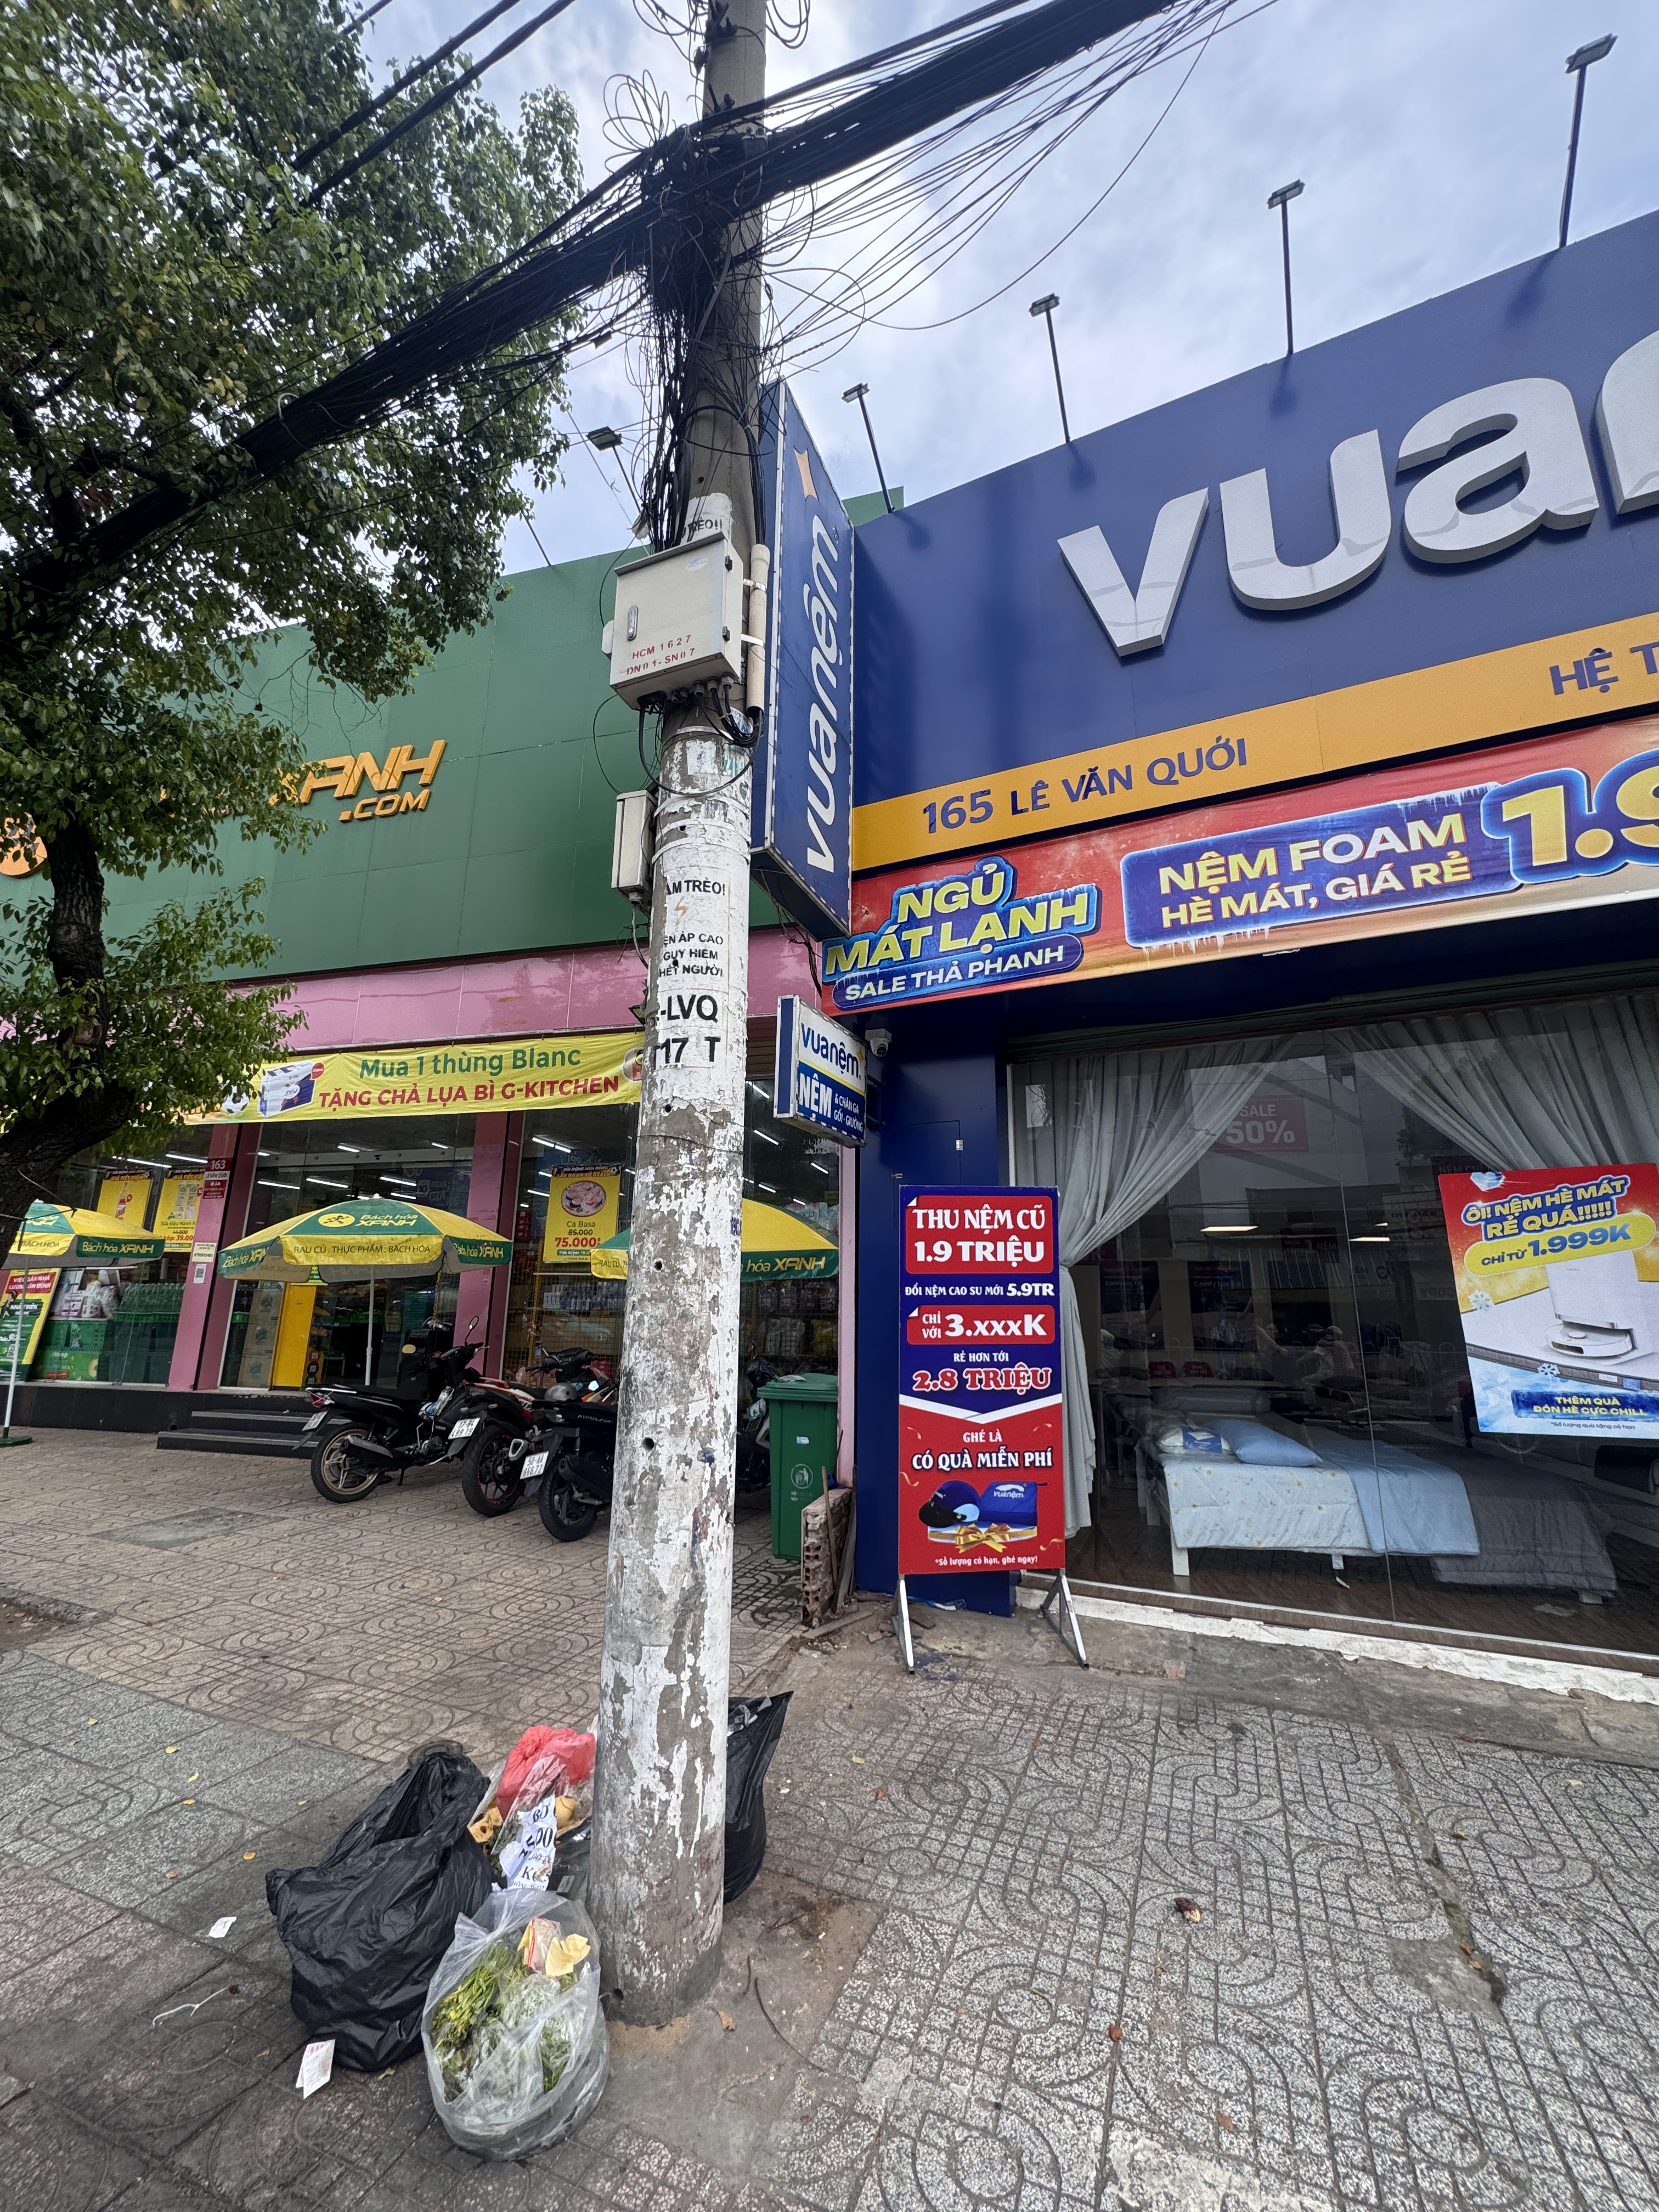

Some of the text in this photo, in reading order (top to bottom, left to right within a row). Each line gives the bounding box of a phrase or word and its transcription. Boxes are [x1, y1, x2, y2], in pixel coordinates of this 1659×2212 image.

[632, 634, 691, 660] HCM 1627
[1549, 647, 1618, 696] HỆ
[923, 735, 1247, 834] 165 LÊ VĂN QUỚI
[338, 788, 431, 824] .COM
[1159, 812, 1467, 896] NỆM FOAM
[897, 862, 1006, 924] NGỦ
[1161, 848, 1472, 929] HÈ MÁT, GIÁ RẺ
[698, 933, 724, 946] CAO
[824, 892, 1089, 977] MÁT LẠNH
[845, 944, 1065, 1002] SALE THẢ PHANH
[359, 1047, 582, 1079] Mua 1 thùng Blanc
[704, 1036, 721, 1063] T
[801, 1022, 859, 1079] vuanệm
[319, 1075, 619, 1113] TẶNG CHẢ LỤA BÌ G-KITCHEN
[799, 1073, 832, 1121] NỆM
[1226, 1120, 1295, 1144] 50%
[211, 1160, 226, 1170] 163
[1494, 1196, 1543, 1218] NỆM
[1545, 1189, 1574, 1206] HÈ
[1577, 1178, 1626, 1200] MÁT
[912, 1204, 1046, 1235] THU NỆM CŨ
[1486, 1215, 1519, 1239] RẺ
[82, 1242, 155, 1254] Bách hóa XANH
[332, 1244, 357, 1255] THỰC
[388, 1244, 410, 1253] BÁCH
[412, 1244, 431, 1252] HÓA
[914, 1235, 1045, 1268] 1.9 TRIỆU
[1481, 1222, 1632, 1267] CHỈ TỪ 1.999K
[746, 1259, 771, 1273] hóa
[772, 1256, 826, 1272] XANH
[905, 1282, 1055, 1297] ĐỔI NỆM CAO SU MỚI 5.9TR
[922, 1310, 941, 1325] CHỈ
[922, 1325, 942, 1339] VỚI
[953, 1350, 1009, 1363] RẺ HƠN TỚI
[912, 1361, 1052, 1395] 2.8 TRIỆU
[1533, 1403, 1648, 1417] ĐÓN HÈ CỰC CHILL
[1555, 1395, 1621, 1406] THÊM QUÀ
[963, 1428, 1003, 1443] GHÉ LÀ
[912, 1444, 1053, 1471] CÓ QUÀ MIỄN PHÍ
[1002, 1555, 1015, 1565] ghé
[1017, 1555, 1039, 1565] ngay!
